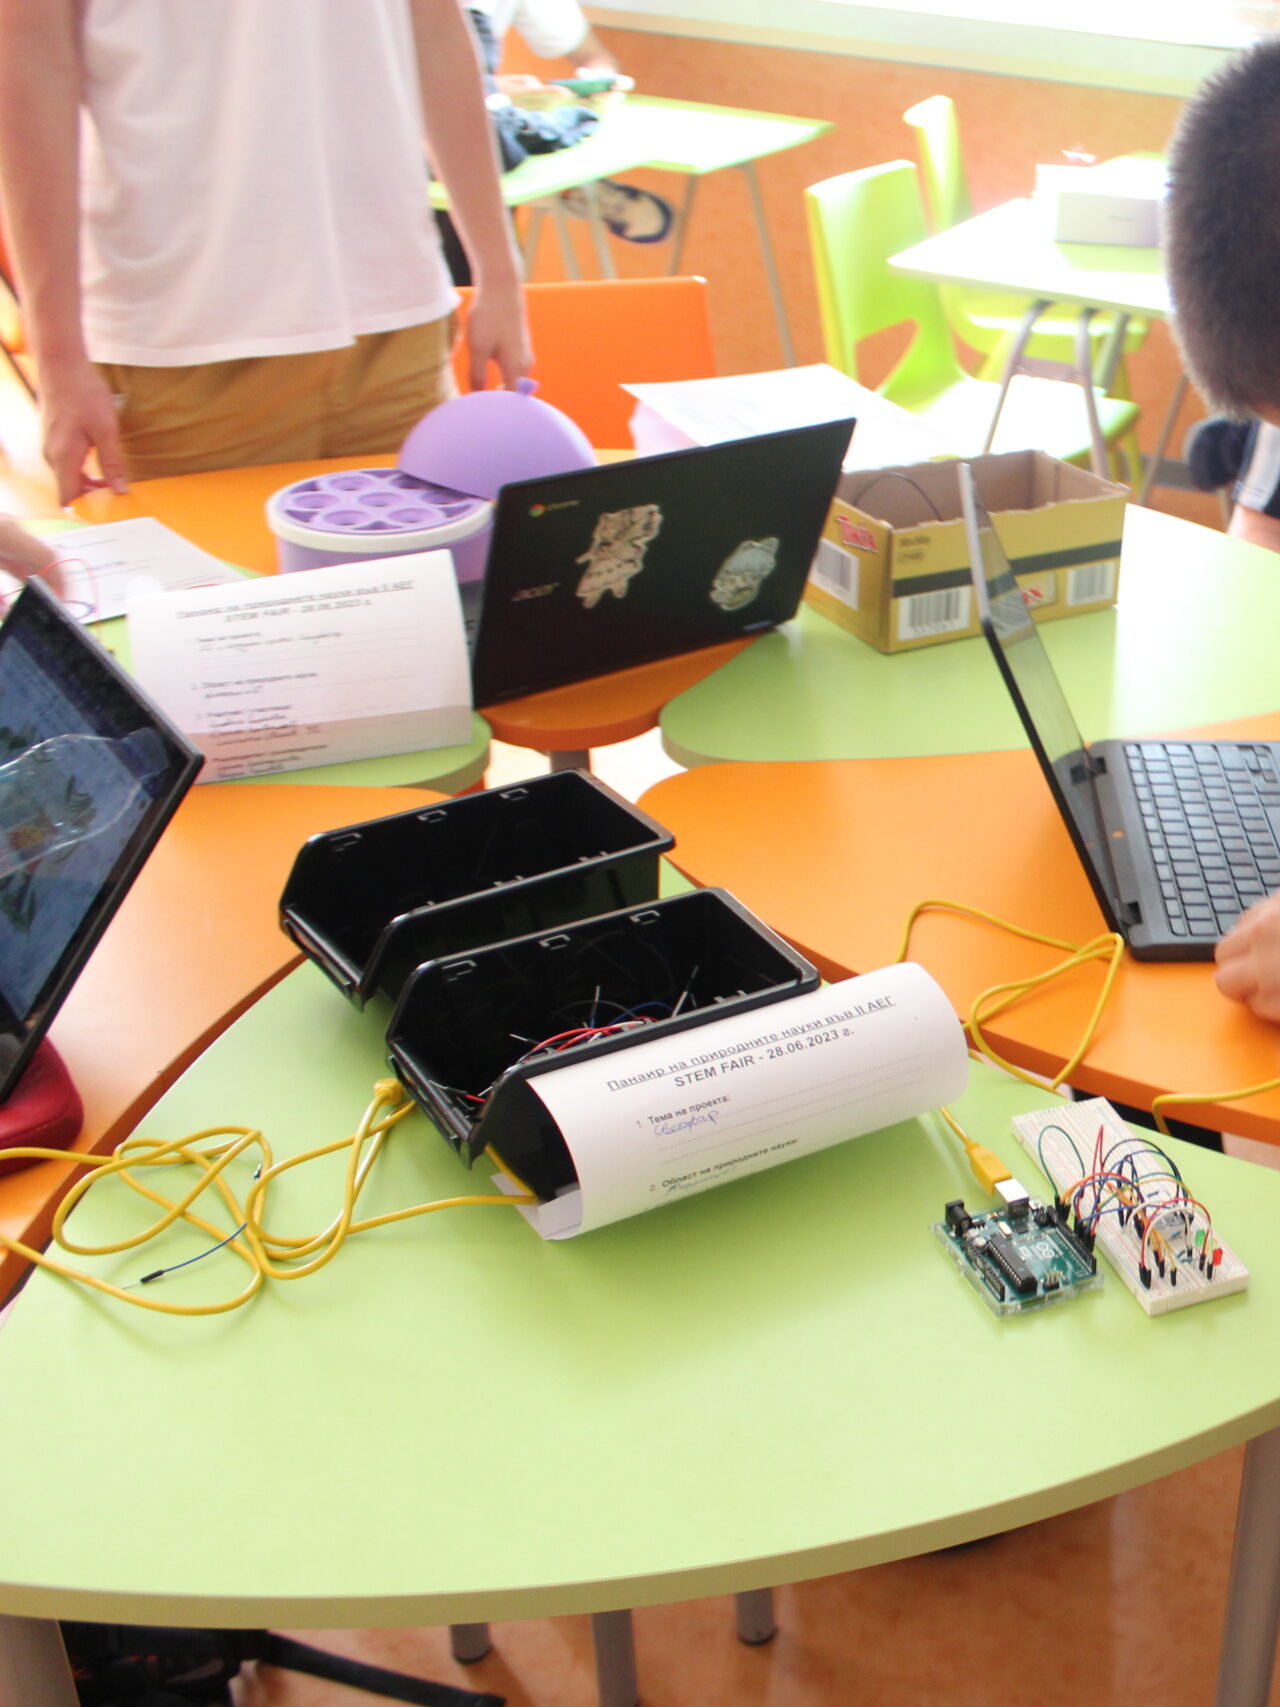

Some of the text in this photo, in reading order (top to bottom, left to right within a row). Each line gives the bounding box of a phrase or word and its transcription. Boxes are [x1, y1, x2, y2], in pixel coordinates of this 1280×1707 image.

[606, 1068, 665, 1092] Панаир
[668, 1061, 688, 1075] на
[690, 1033, 778, 1066] природните
[779, 1019, 823, 1039] науки
[825, 1010, 853, 1026] във
[674, 1065, 717, 1088] STEM
[720, 1054, 756, 1074] FAIR
[765, 1027, 840, 1060] 28.06.2023
[648, 1111, 673, 1124] Тема
[675, 1107, 688, 1118] на
[662, 1172, 697, 1188] Област
[699, 1166, 711, 1176] на
[713, 1148, 769, 1171] природните
